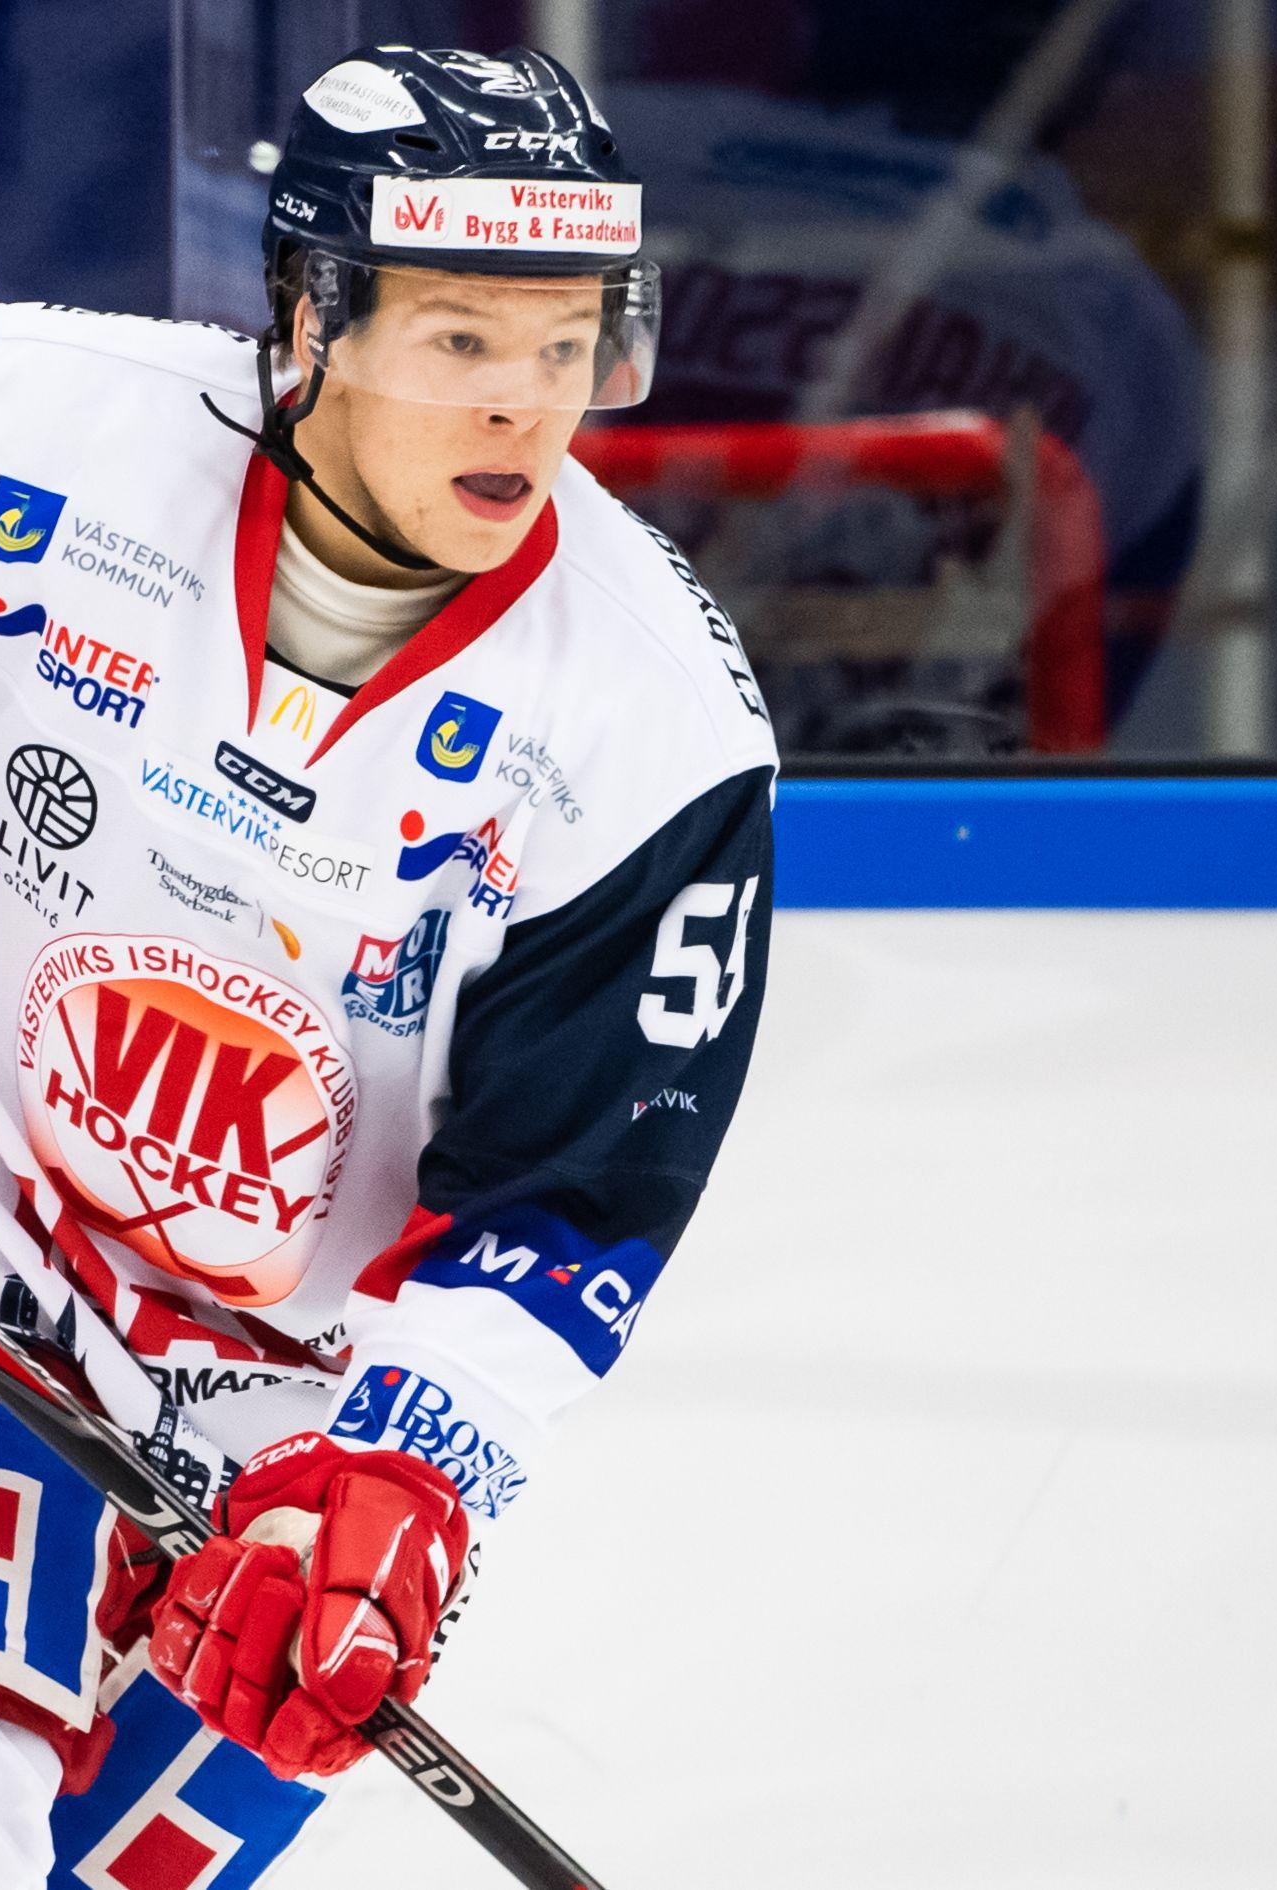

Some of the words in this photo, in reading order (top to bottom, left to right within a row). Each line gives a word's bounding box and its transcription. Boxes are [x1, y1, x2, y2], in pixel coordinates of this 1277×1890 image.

[483, 132, 578, 152] CCM
[511, 184, 614, 211] Västerviks
[466, 214, 520, 244] Bygg
[528, 216, 543, 239] &
[552, 217, 638, 243] Fasadteknik
[61, 544, 173, 608] KOMMUN
[74, 516, 205, 602] VÄSTERVIKS
[35, 649, 146, 729] SPORT
[218, 751, 311, 811] CCM
[15, 870, 41, 896] FAM
[127, 945, 322, 1038] ISHOCKEY
[309, 1045, 355, 1147] KLUBB
[93, 983, 303, 1182] VIK
[45, 1067, 317, 1235] HOCKEY
[244, 1436, 321, 1476] CCM
